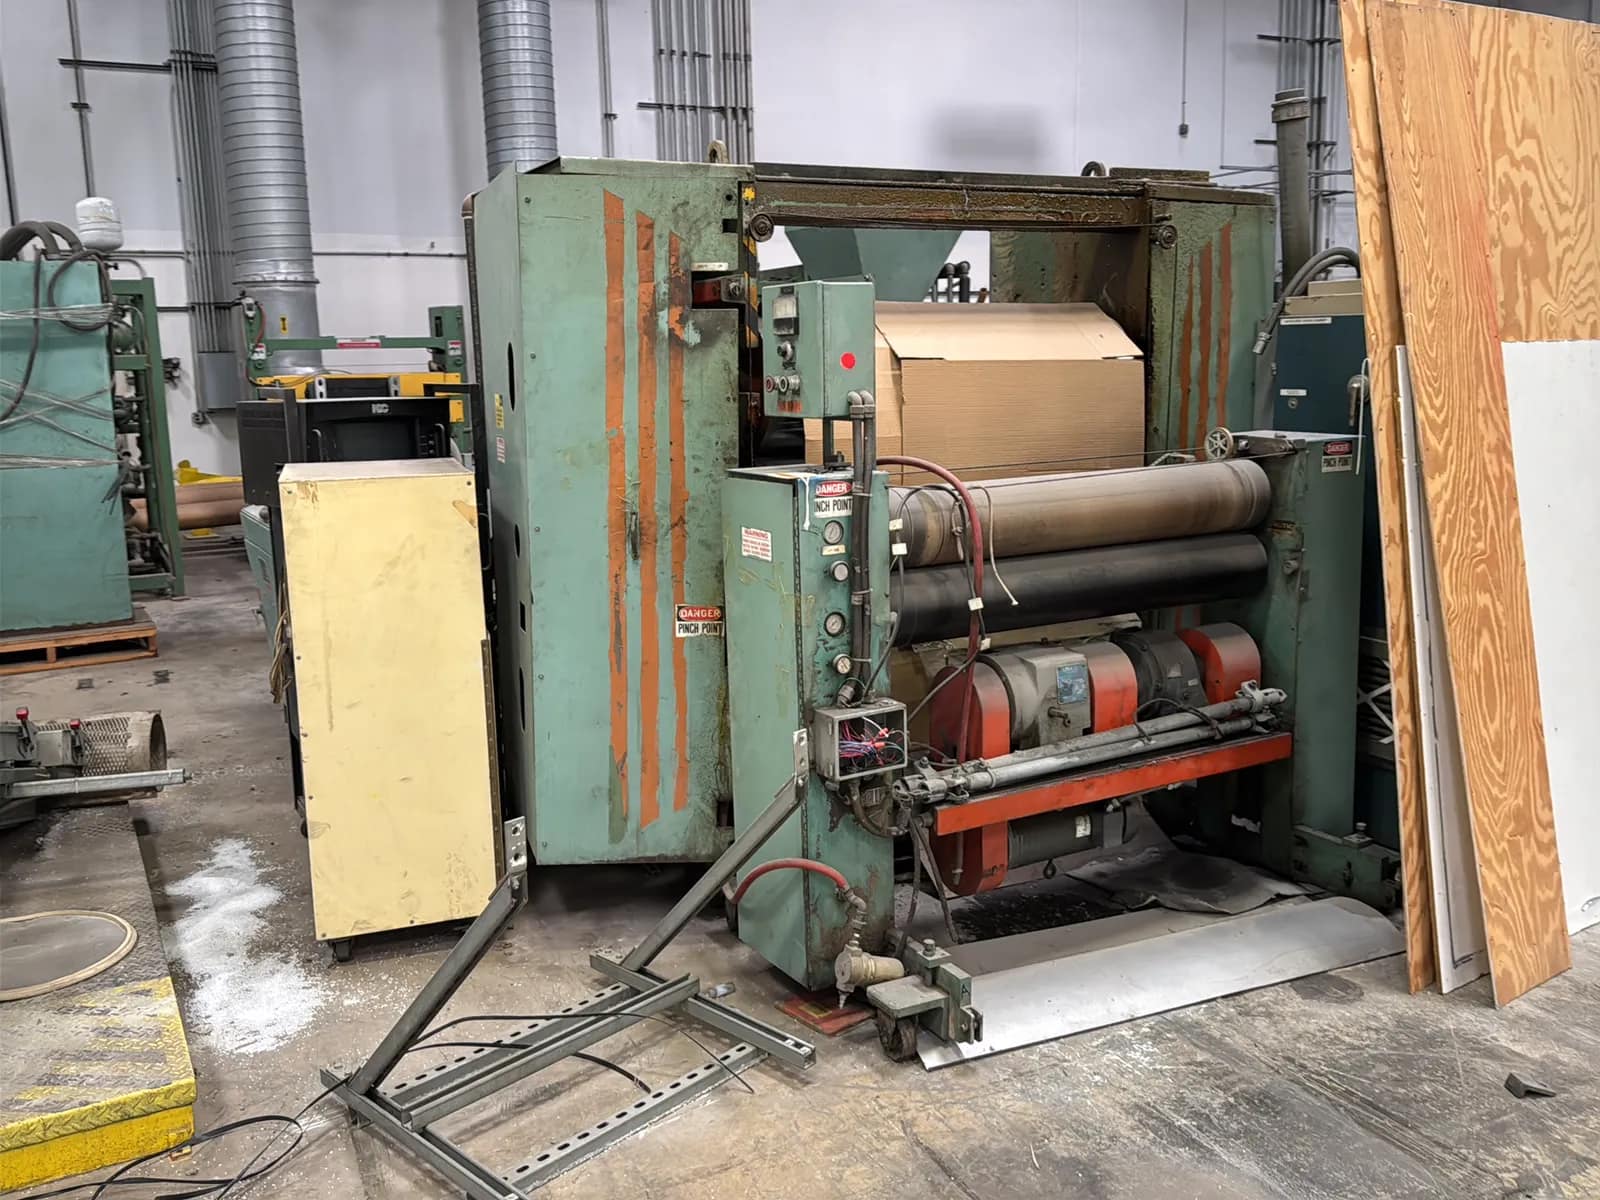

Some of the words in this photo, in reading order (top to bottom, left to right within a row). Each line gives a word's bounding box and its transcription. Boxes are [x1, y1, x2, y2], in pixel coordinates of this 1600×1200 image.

[816, 482, 847, 494] DANGER
[814, 499, 830, 512] INCH
[832, 498, 852, 512] POINT
[679, 609, 721, 618] DANGER
[678, 622, 699, 634] PINCH
[701, 622, 722, 634] POINT
